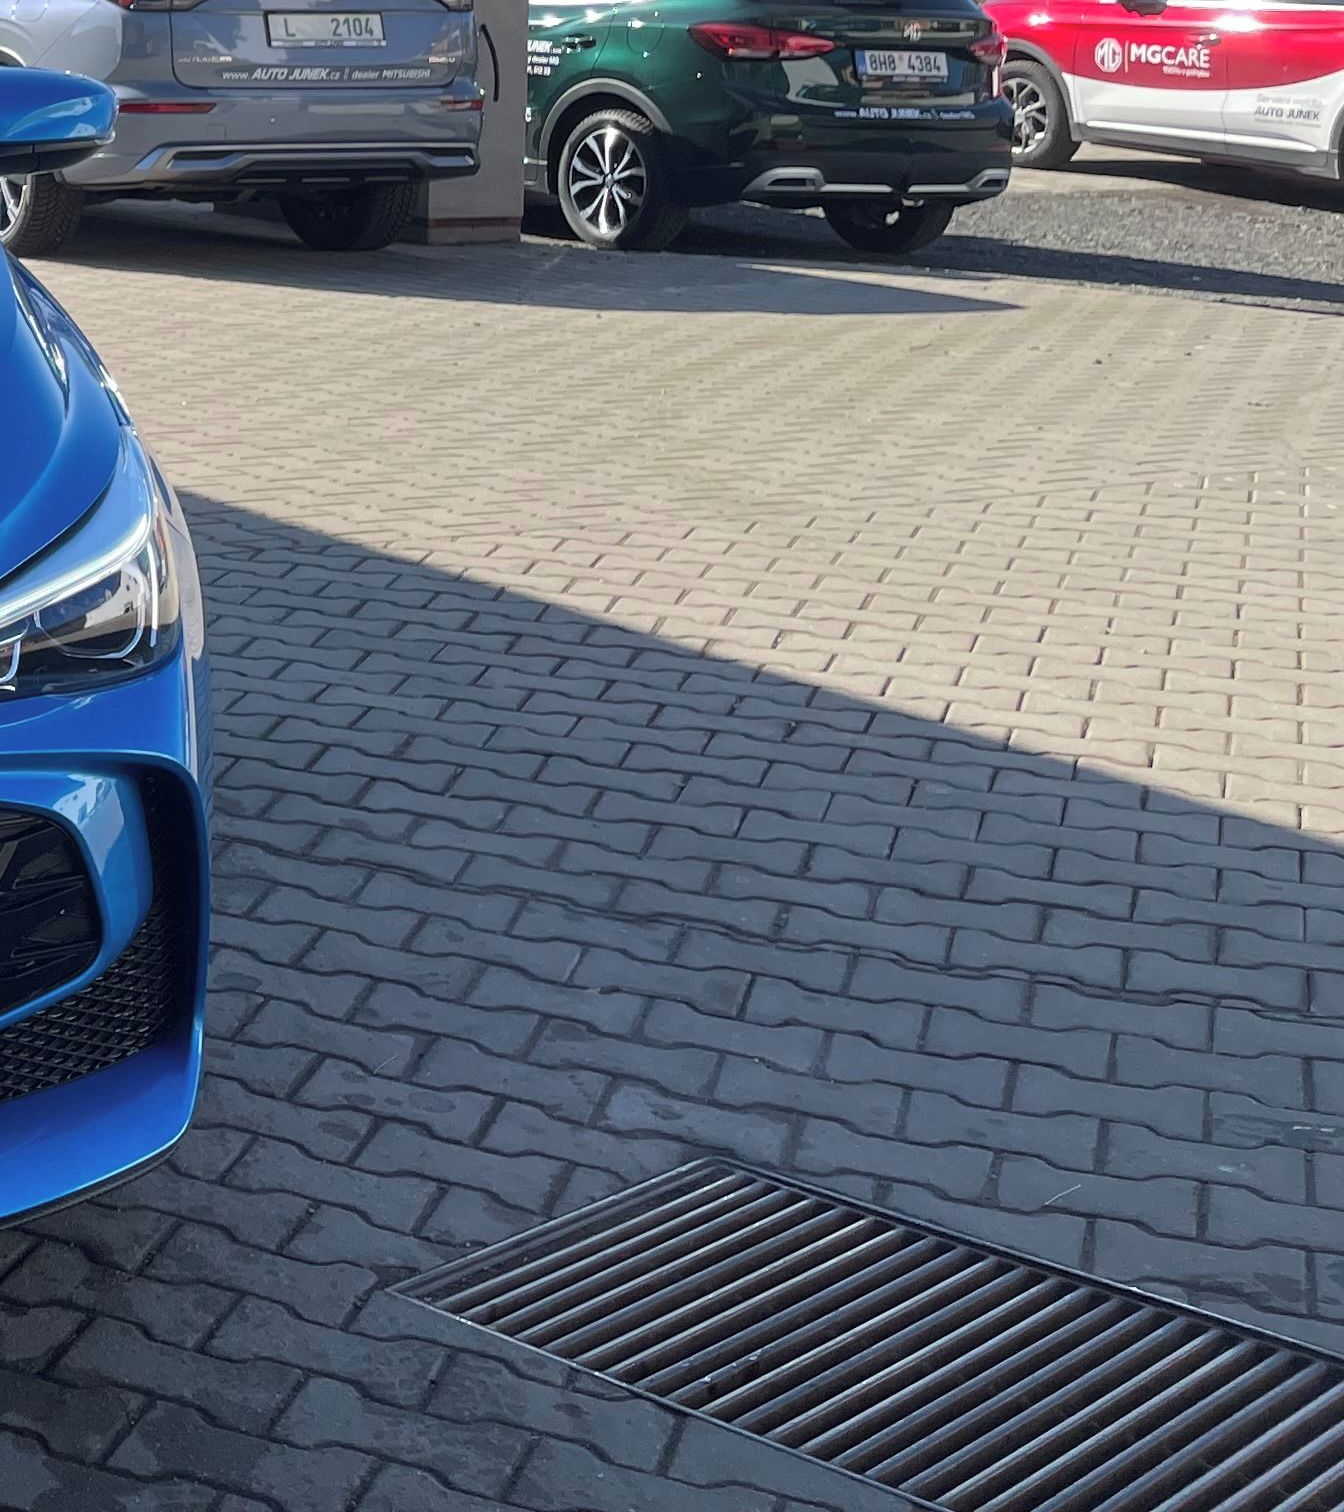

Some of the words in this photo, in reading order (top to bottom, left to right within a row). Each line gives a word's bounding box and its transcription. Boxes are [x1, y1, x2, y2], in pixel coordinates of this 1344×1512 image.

[283, 17, 296, 37] L
[330, 17, 374, 37] 2104
[907, 55, 941, 72] 4384
[1097, 39, 1121, 70] MG
[252, 67, 287, 80] AUTO
